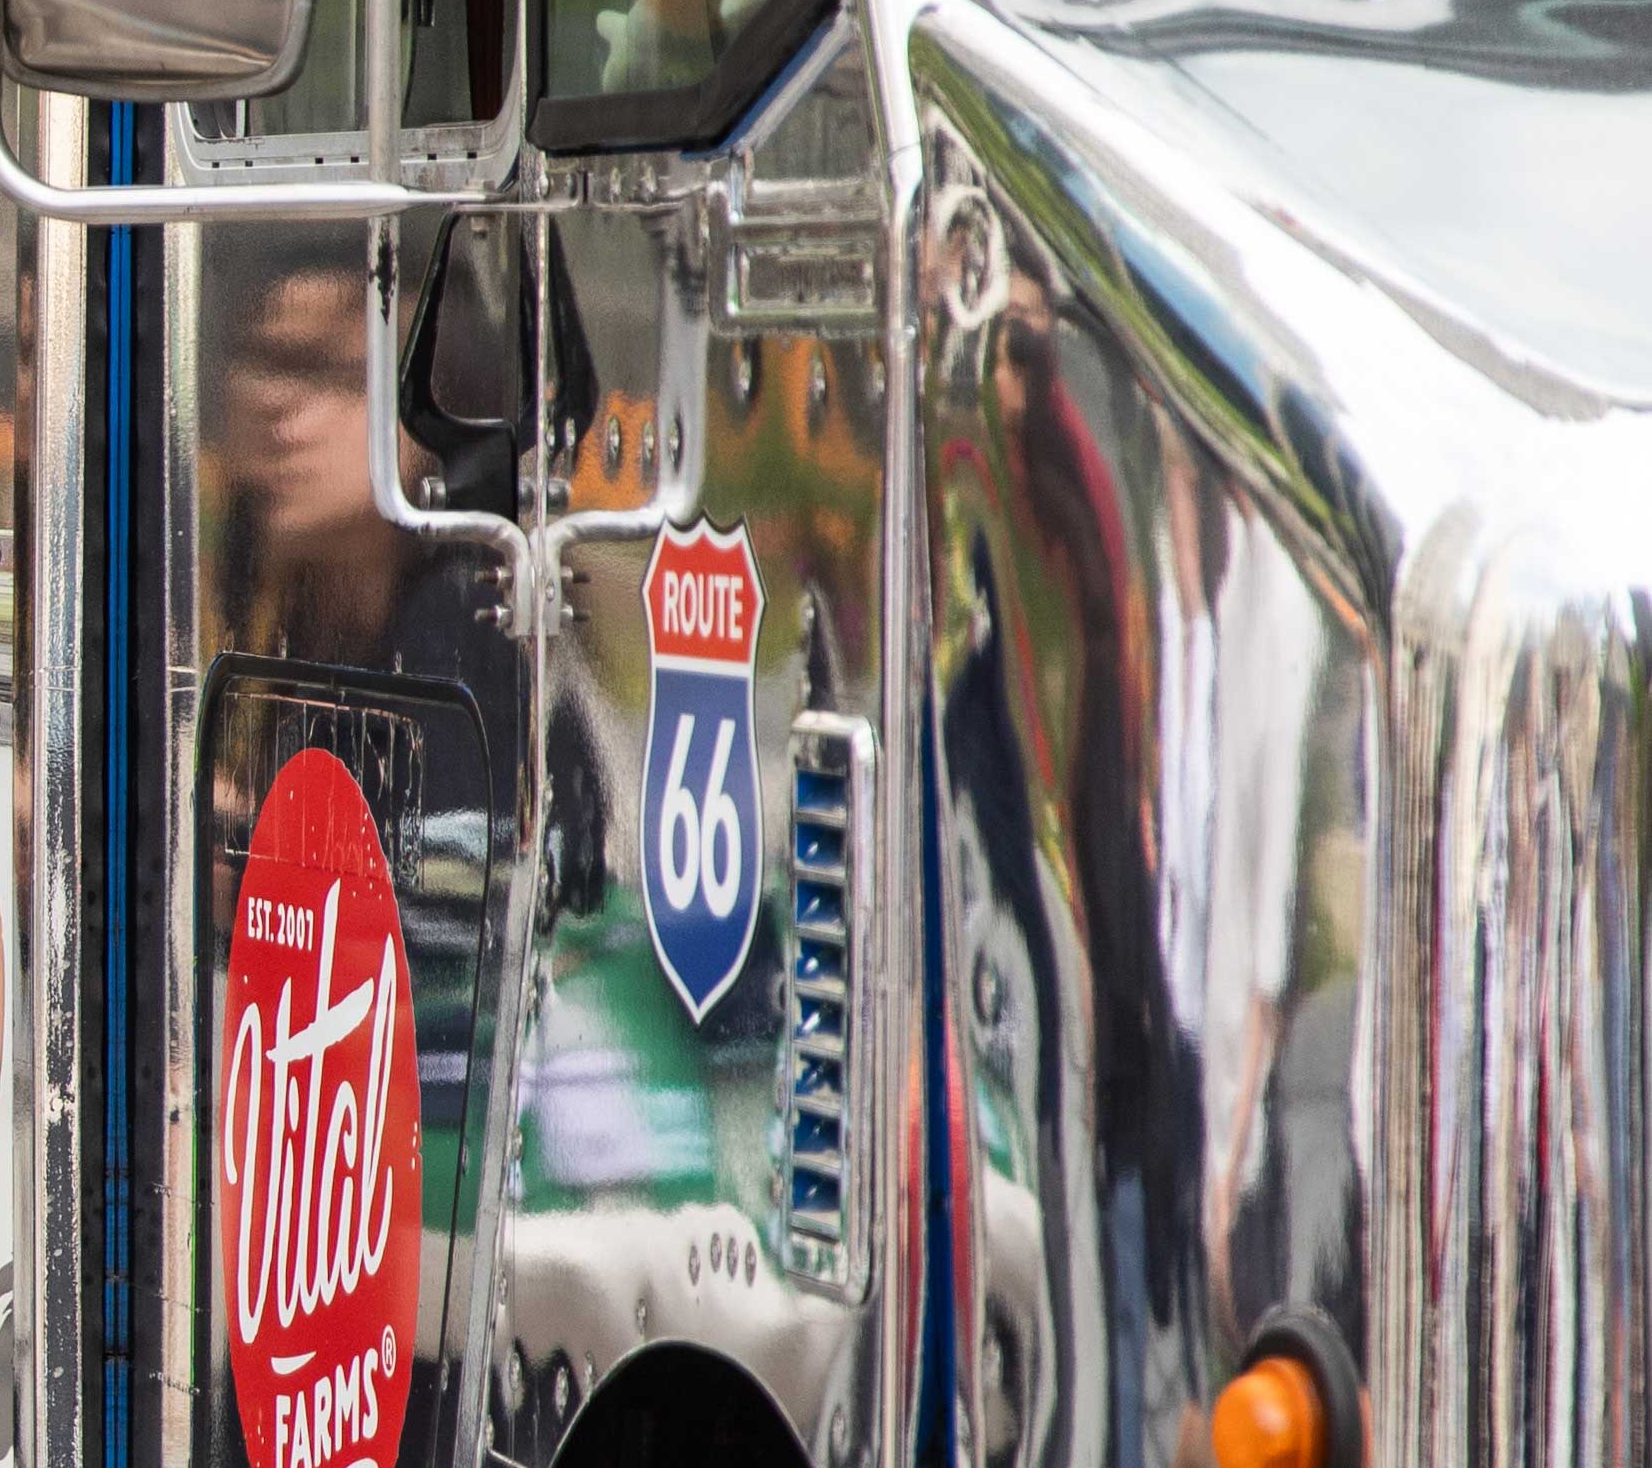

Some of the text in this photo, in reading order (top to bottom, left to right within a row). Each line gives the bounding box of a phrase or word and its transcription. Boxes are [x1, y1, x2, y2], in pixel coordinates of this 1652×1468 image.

[662, 569, 744, 640] ROUTE
[659, 713, 742, 918] 66
[225, 878, 397, 1344] Vital
